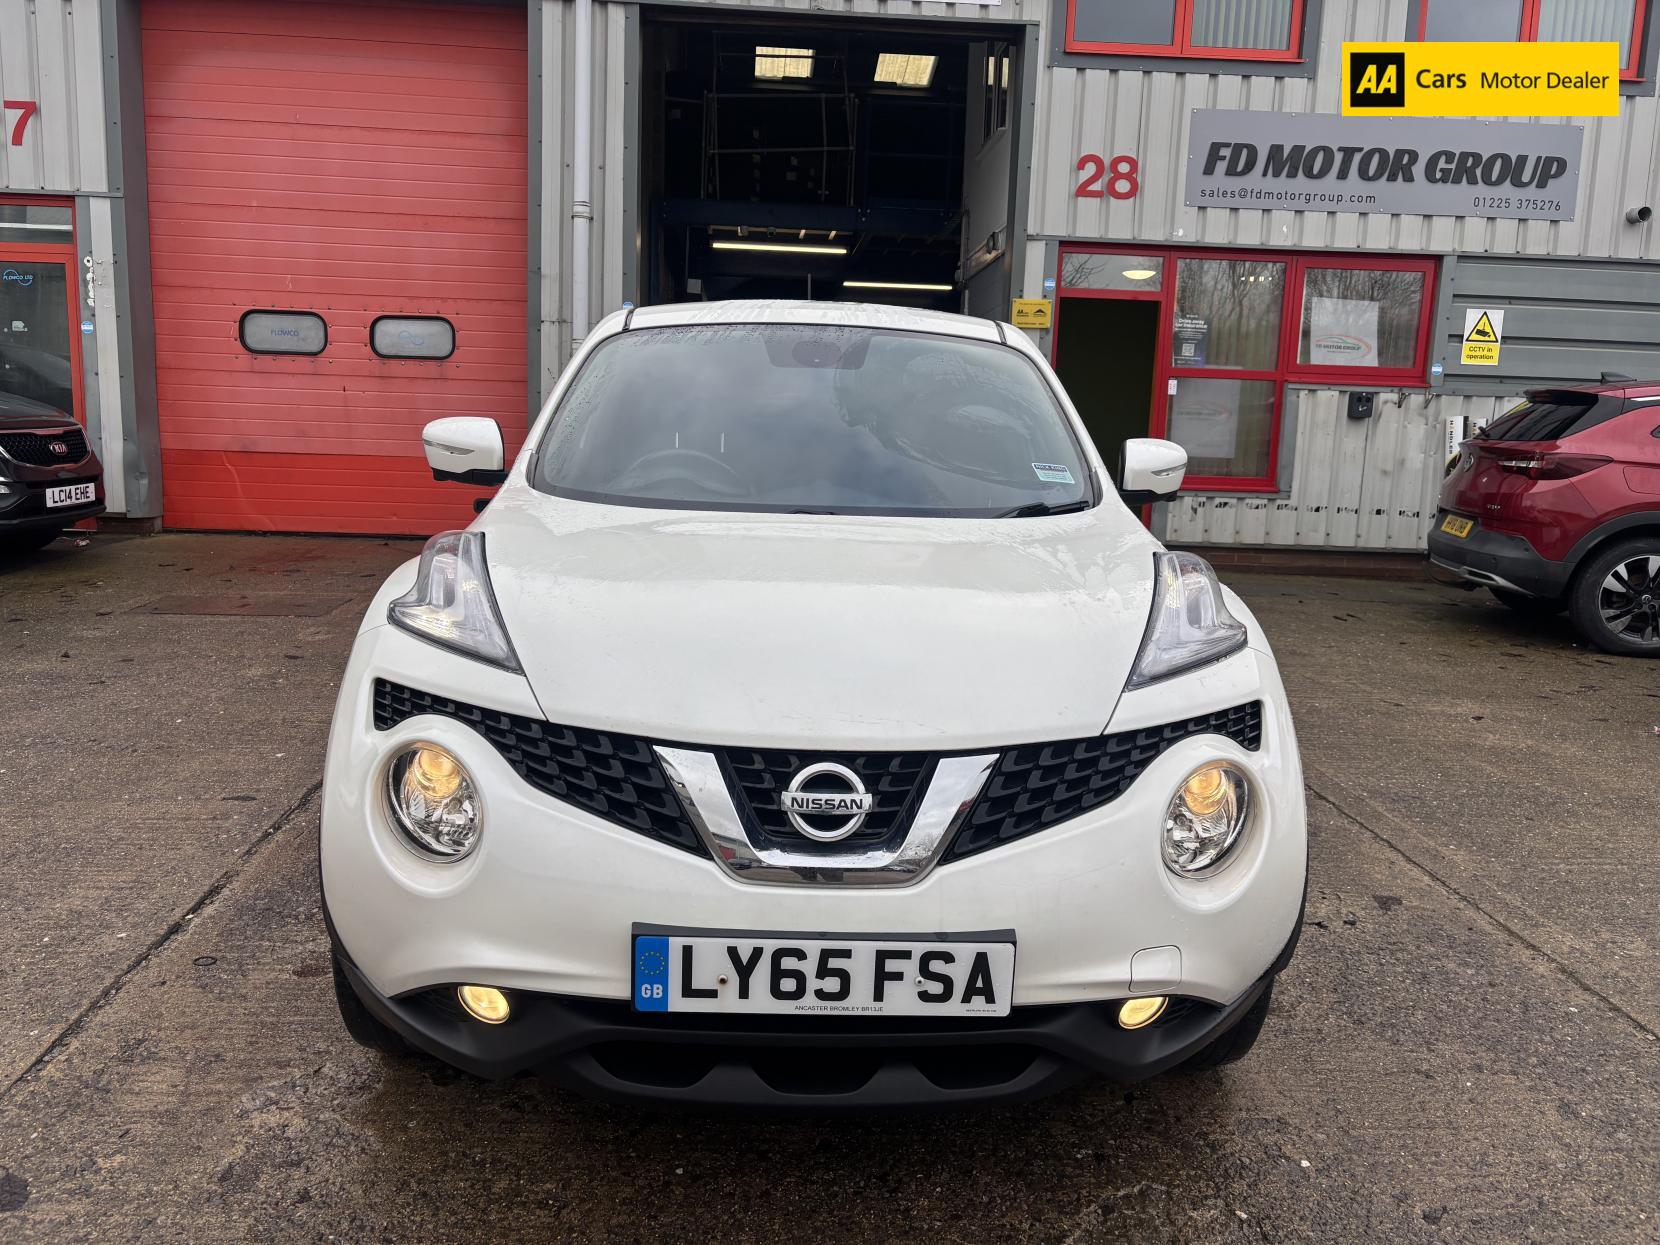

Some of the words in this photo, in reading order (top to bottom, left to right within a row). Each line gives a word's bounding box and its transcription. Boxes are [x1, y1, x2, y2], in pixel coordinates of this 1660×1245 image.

[3, 100, 37, 146] 7
[1202, 141, 1259, 177] FD
[1261, 143, 1420, 183] MOTOR
[1424, 149, 1568, 189] GROUP
[1075, 153, 1139, 200] 28
[1200, 186, 1376, 205] sales@fdmotorgroup.com
[1473, 196, 1512, 209] 01225
[1516, 198, 1561, 212] 375276
[270, 329, 300, 337] FLOWCO
[53, 444, 67, 453] KIA
[52, 486, 73, 504] LC14
[74, 485, 91, 501] EHE
[790, 796, 863, 811] NISSAN
[681, 944, 853, 1002] LY65
[872, 949, 997, 1005] FSA
[641, 983, 664, 999] GB
